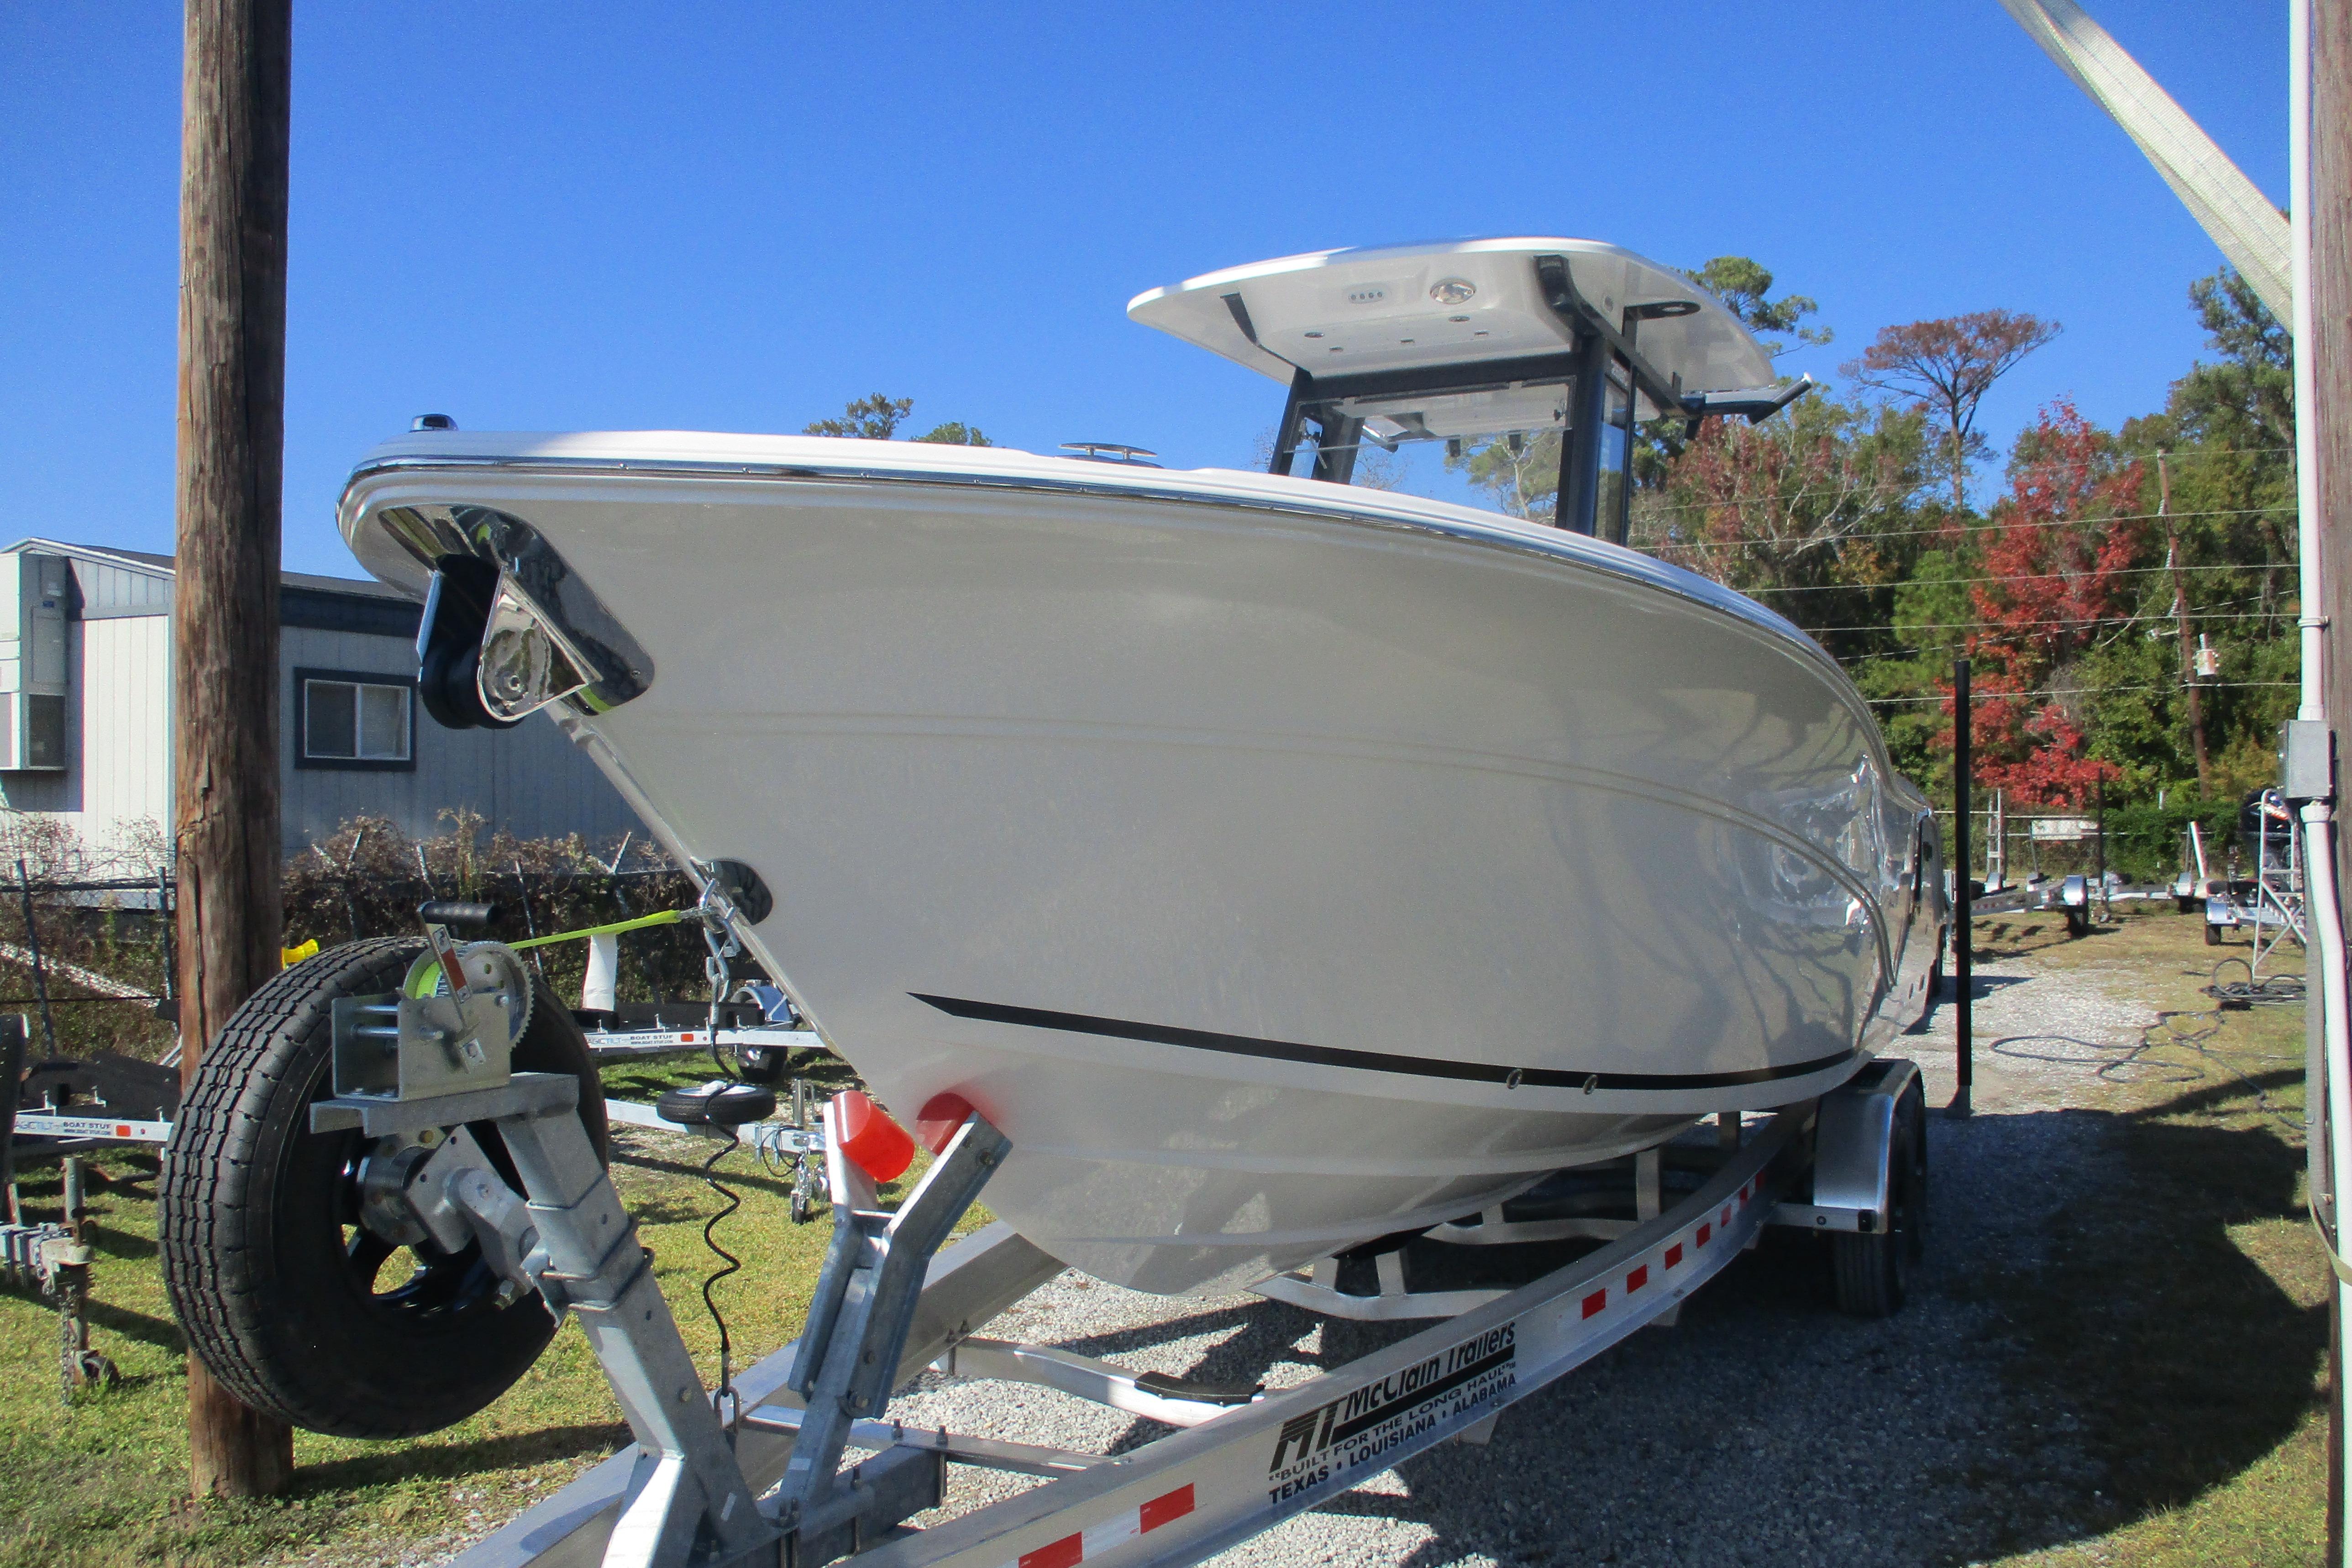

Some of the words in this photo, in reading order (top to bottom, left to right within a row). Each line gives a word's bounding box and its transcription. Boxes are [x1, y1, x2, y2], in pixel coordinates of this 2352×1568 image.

[1344, 1357, 1440, 1421] McClain
[1447, 1322, 1515, 1374] Trailers
[1269, 1465, 1329, 1504] TEXAS
[1349, 1414, 1436, 1468] LOUISIANA
[1453, 1373, 1516, 1416] ALABAMA
[1334, 1433, 1369, 1456] FOR
[1372, 1416, 1402, 1437] THE
[1409, 1389, 1462, 1421] LONG
